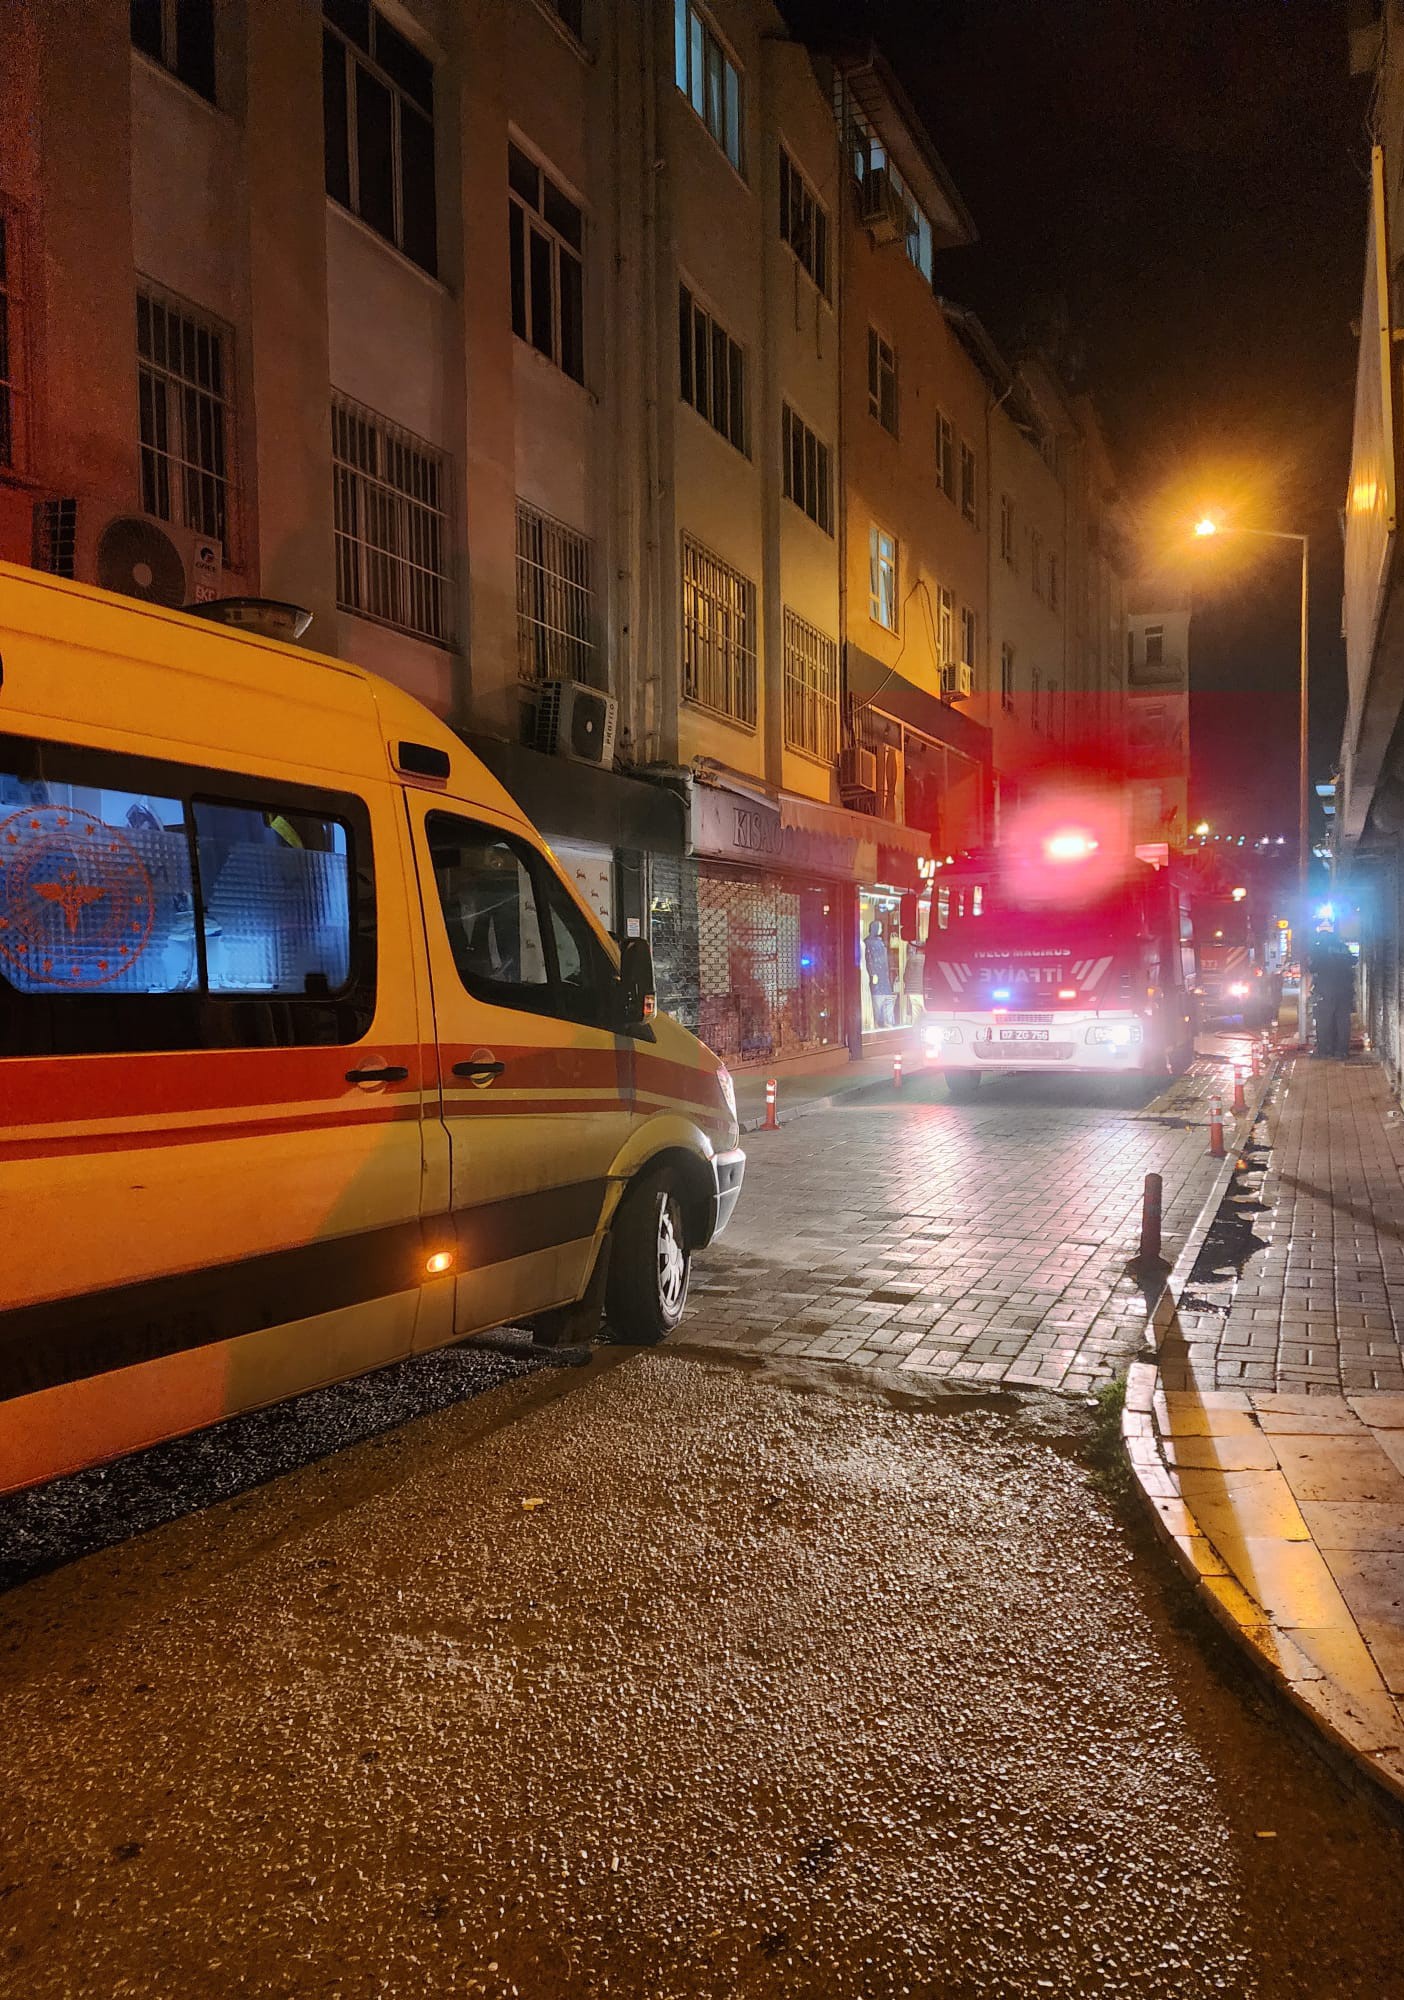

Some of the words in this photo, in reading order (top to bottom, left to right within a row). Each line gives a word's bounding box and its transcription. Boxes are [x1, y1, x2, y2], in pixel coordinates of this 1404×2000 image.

[606, 704, 614, 744] PROFILO
[1002, 1031, 1012, 1039] 07
[1015, 1031, 1029, 1039] ZG
